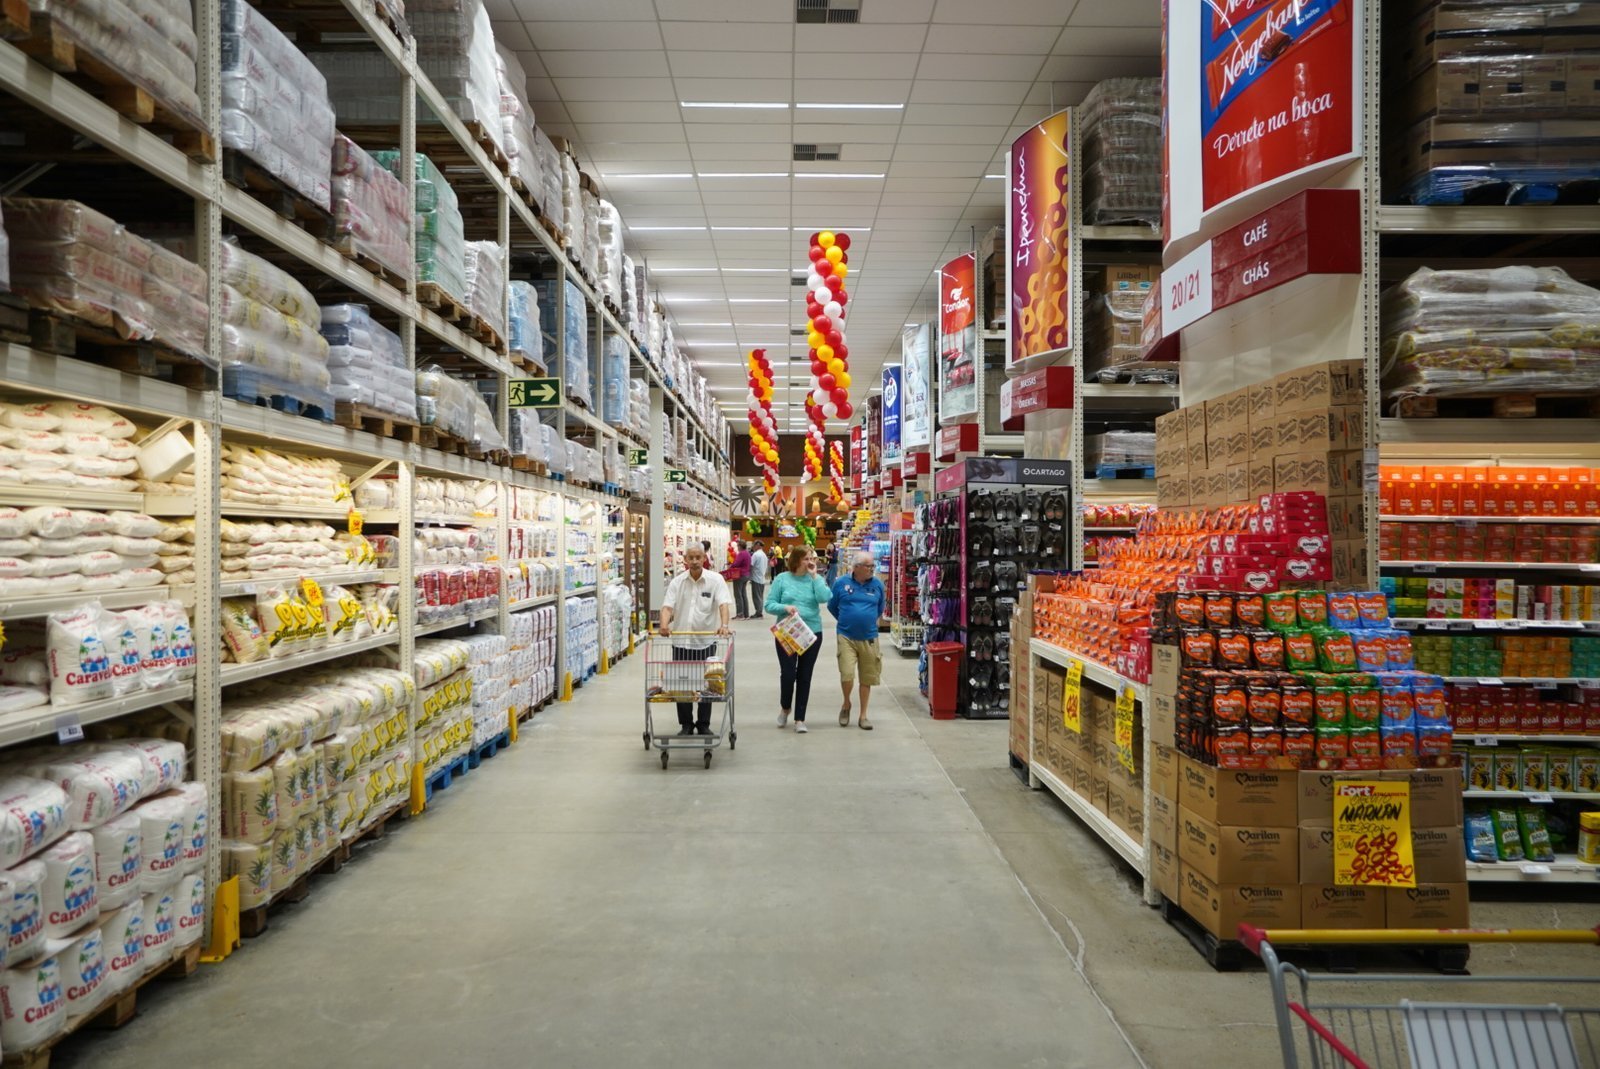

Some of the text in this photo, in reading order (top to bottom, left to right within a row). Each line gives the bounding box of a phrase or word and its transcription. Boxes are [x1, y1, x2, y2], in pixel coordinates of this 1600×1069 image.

[1213, 92, 1333, 159] Derrete na boca
[1013, 146, 1035, 267] Ipanema
[1243, 219, 1268, 247] CAFÉ
[1242, 261, 1270, 285] CHÁS
[1171, 270, 1200, 311] 20/21
[944, 297, 969, 313] Condor
[1020, 376, 1036, 388] MASSAS
[1018, 394, 1037, 408] ORIENTAL
[1235, 772, 1279, 785] Marilan
[1340, 785, 1371, 797] Fort
[1237, 830, 1280, 843] Marilan
[1239, 886, 1283, 900] Marilan
[1322, 888, 1365, 900] Marilan
[1406, 888, 1450, 900] Marilan
